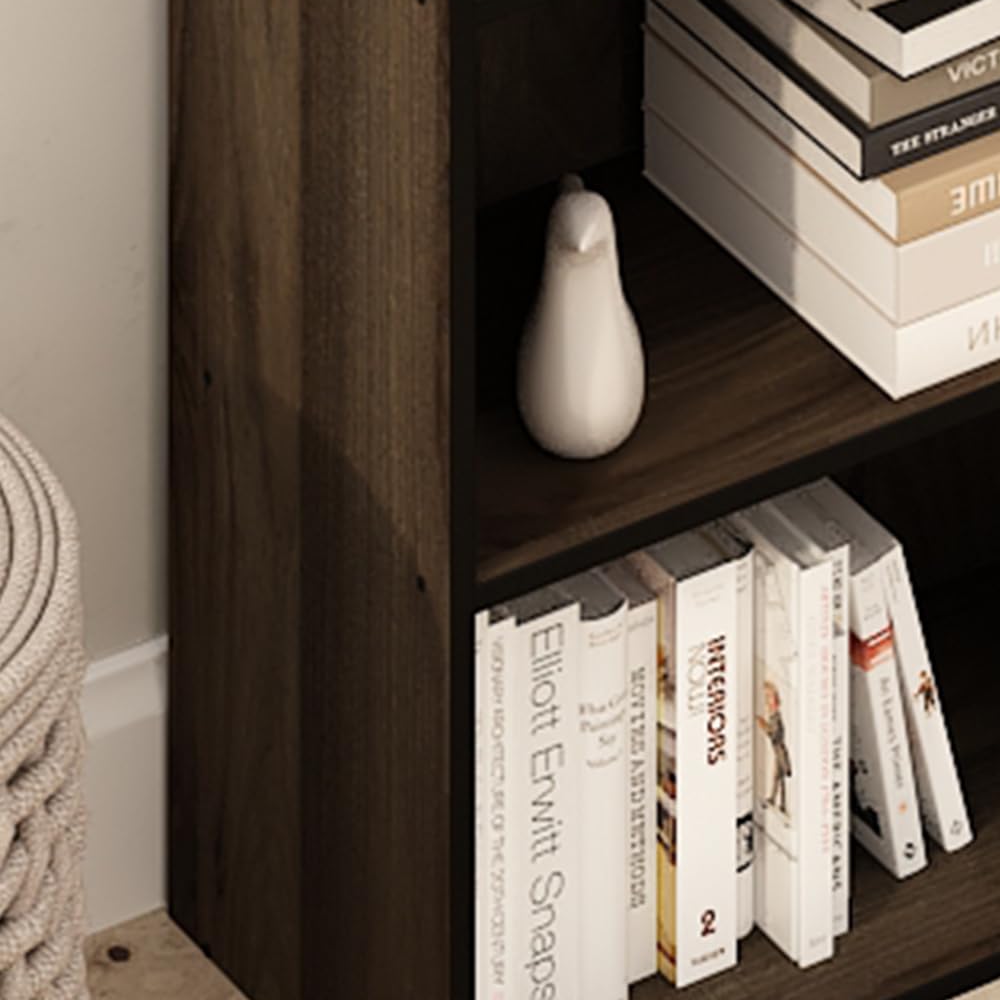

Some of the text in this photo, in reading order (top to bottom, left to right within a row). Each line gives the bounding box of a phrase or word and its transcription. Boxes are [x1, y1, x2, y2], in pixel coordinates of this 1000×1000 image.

[924, 106, 998, 145] STRANGER
[530, 622, 564, 736] Elliott
[707, 635, 726, 767] INTERIORS
[530, 743, 564, 864] Erwitt
[700, 908, 716, 937] 2
